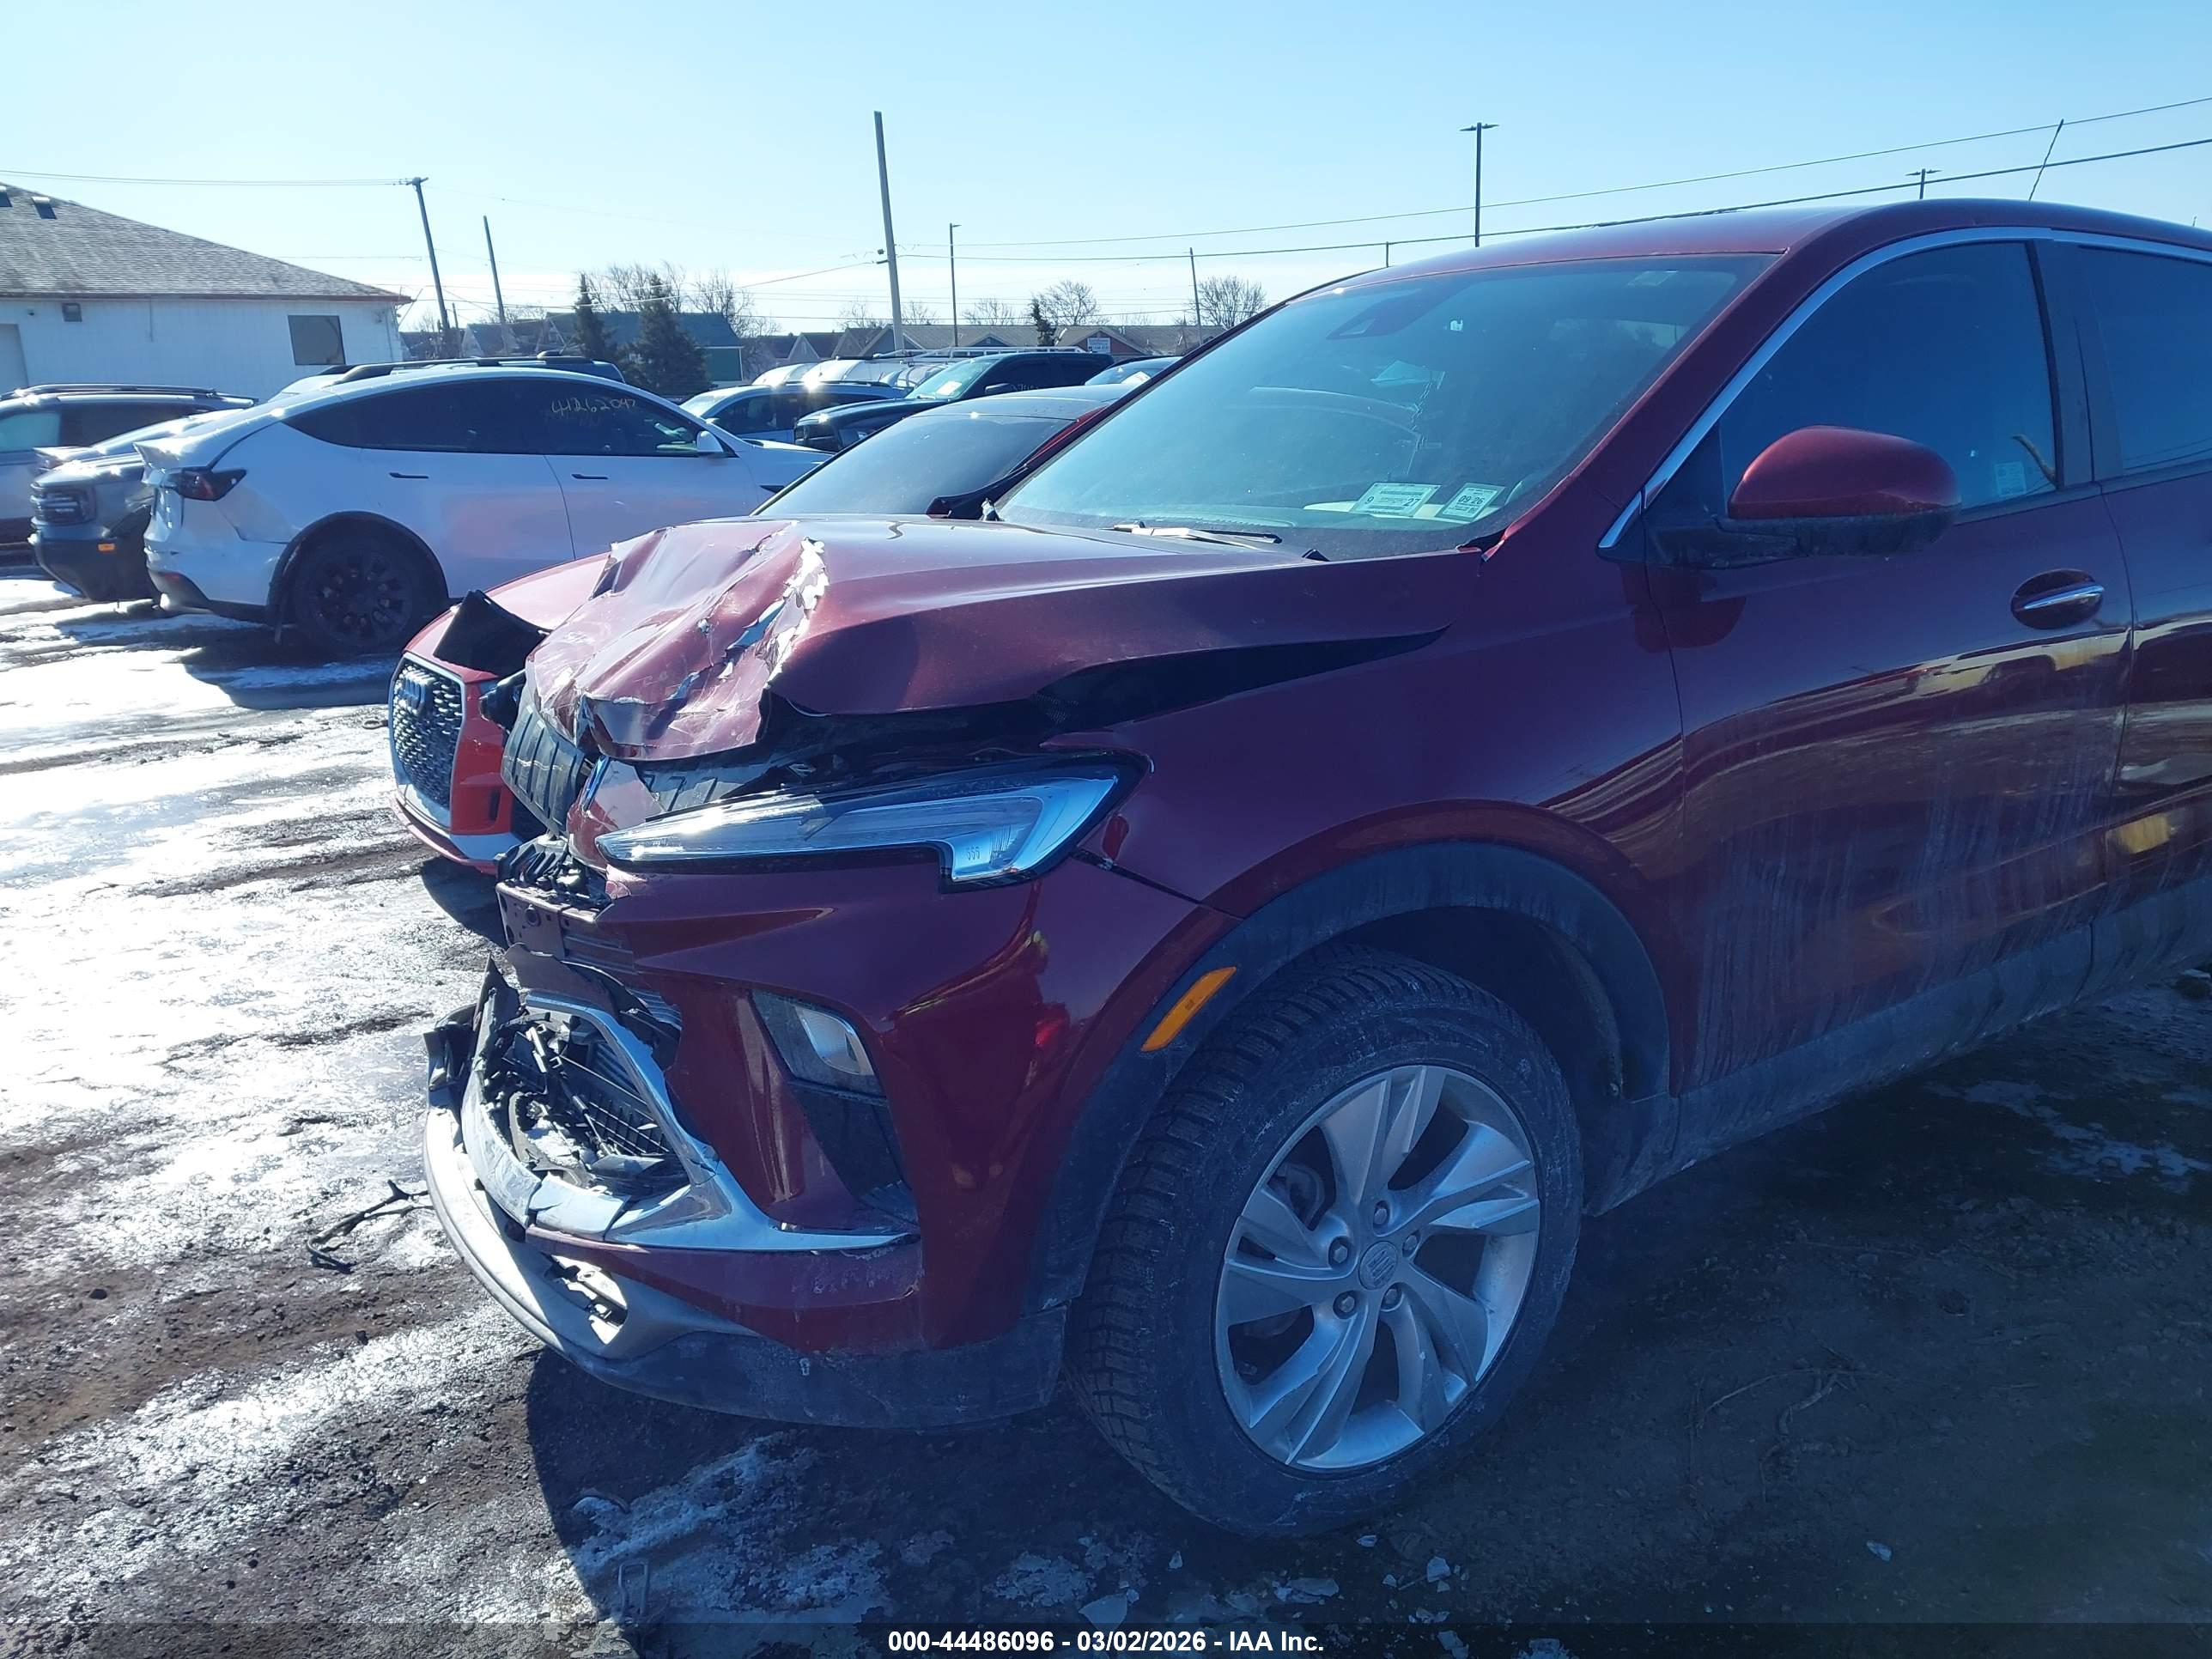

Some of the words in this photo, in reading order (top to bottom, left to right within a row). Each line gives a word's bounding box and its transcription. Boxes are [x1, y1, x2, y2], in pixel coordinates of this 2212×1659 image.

[1364, 495, 1375, 505] 9
[1403, 498, 1422, 507] 27
[1457, 495, 1472, 503] 09
[1471, 496, 1485, 505] 26
